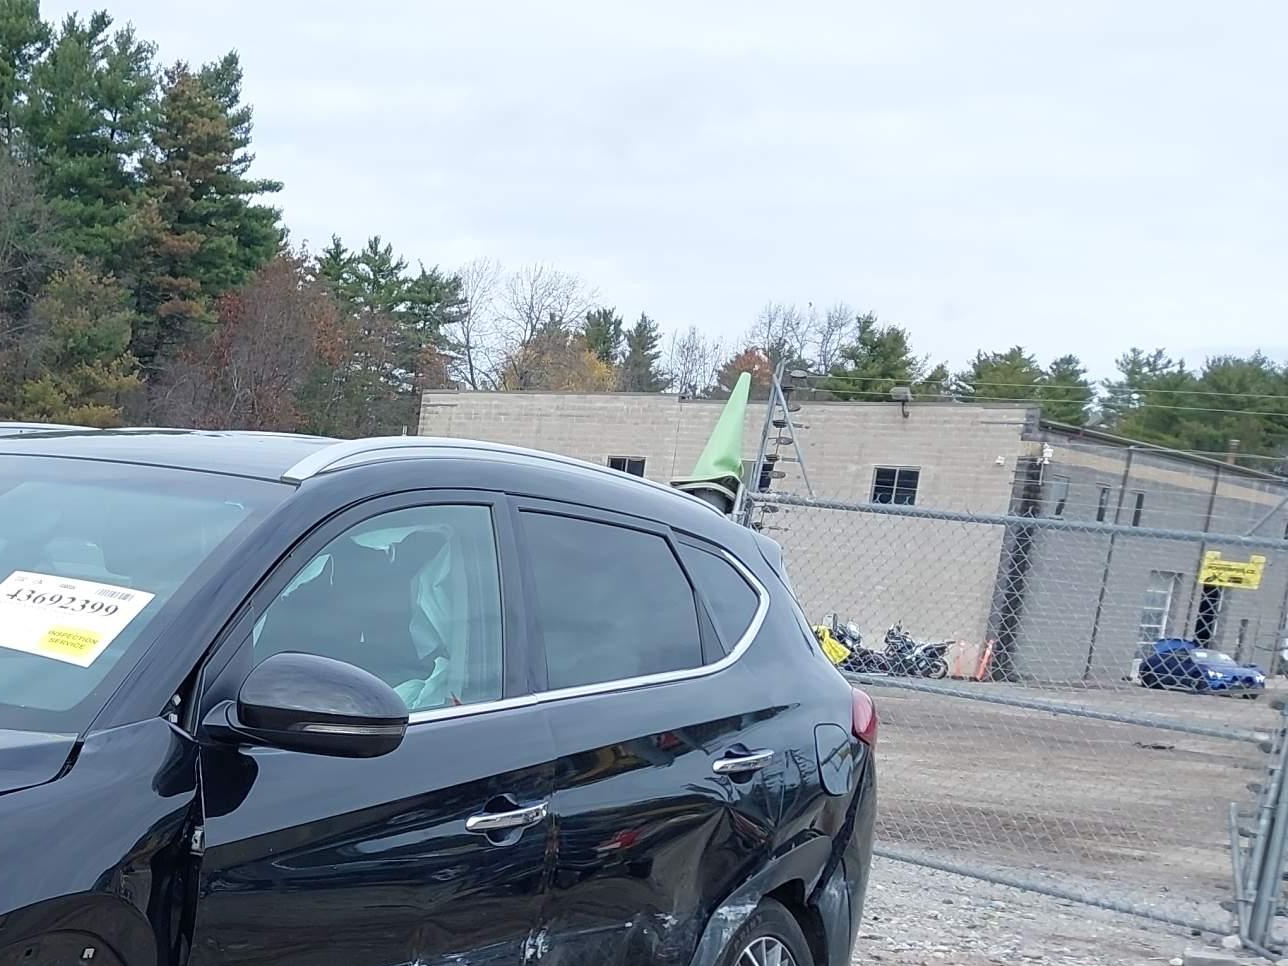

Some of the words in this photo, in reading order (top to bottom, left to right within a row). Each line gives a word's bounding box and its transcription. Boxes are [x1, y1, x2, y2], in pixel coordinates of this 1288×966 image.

[6, 588, 119, 617] 43692399
[47, 629, 100, 646] INSPECTION
[47, 637, 88, 650] SERVICE
